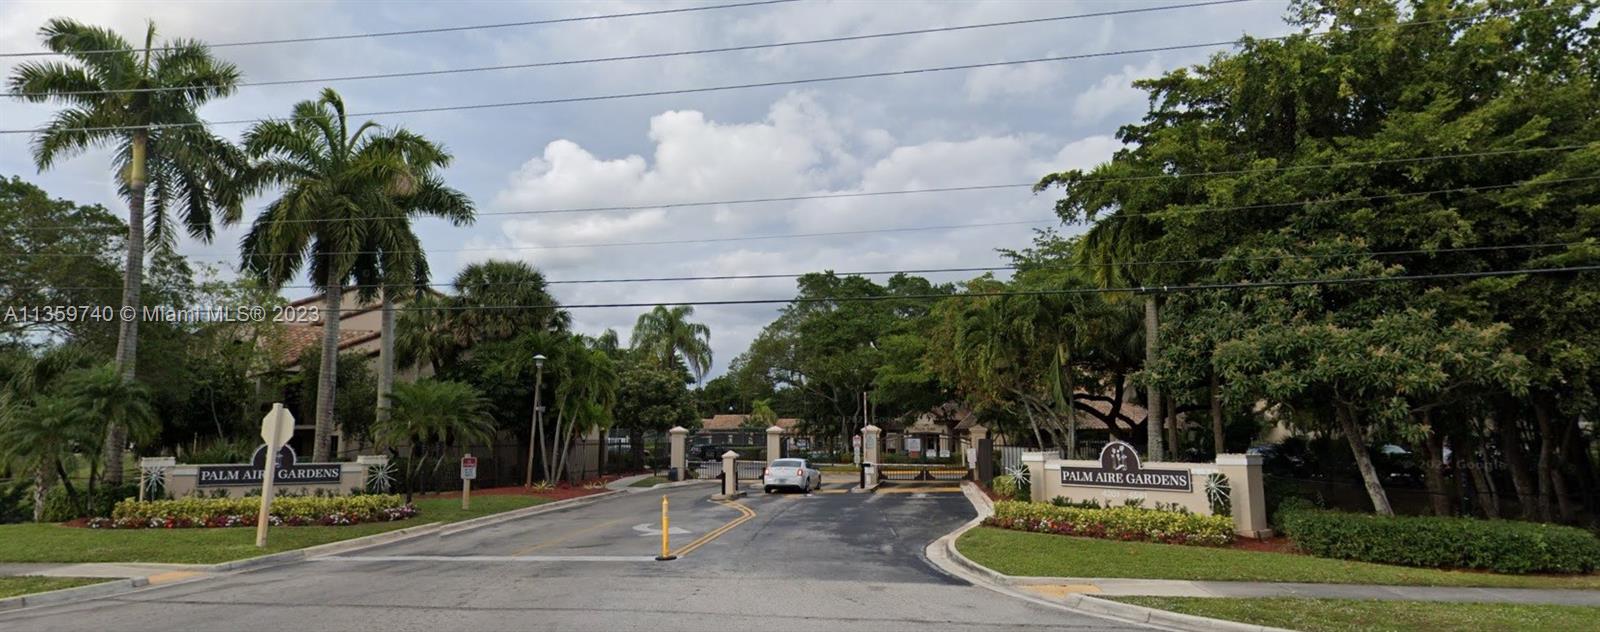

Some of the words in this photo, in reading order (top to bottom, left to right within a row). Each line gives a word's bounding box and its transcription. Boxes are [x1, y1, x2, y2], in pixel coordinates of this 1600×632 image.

[201, 470, 239, 480] PALM
[242, 469, 265, 480] AIR
[277, 468, 339, 479] GARDENS
[1062, 470, 1093, 482] PALM
[1095, 472, 1124, 483] AIRE
[1126, 473, 1187, 486] GARDENS
